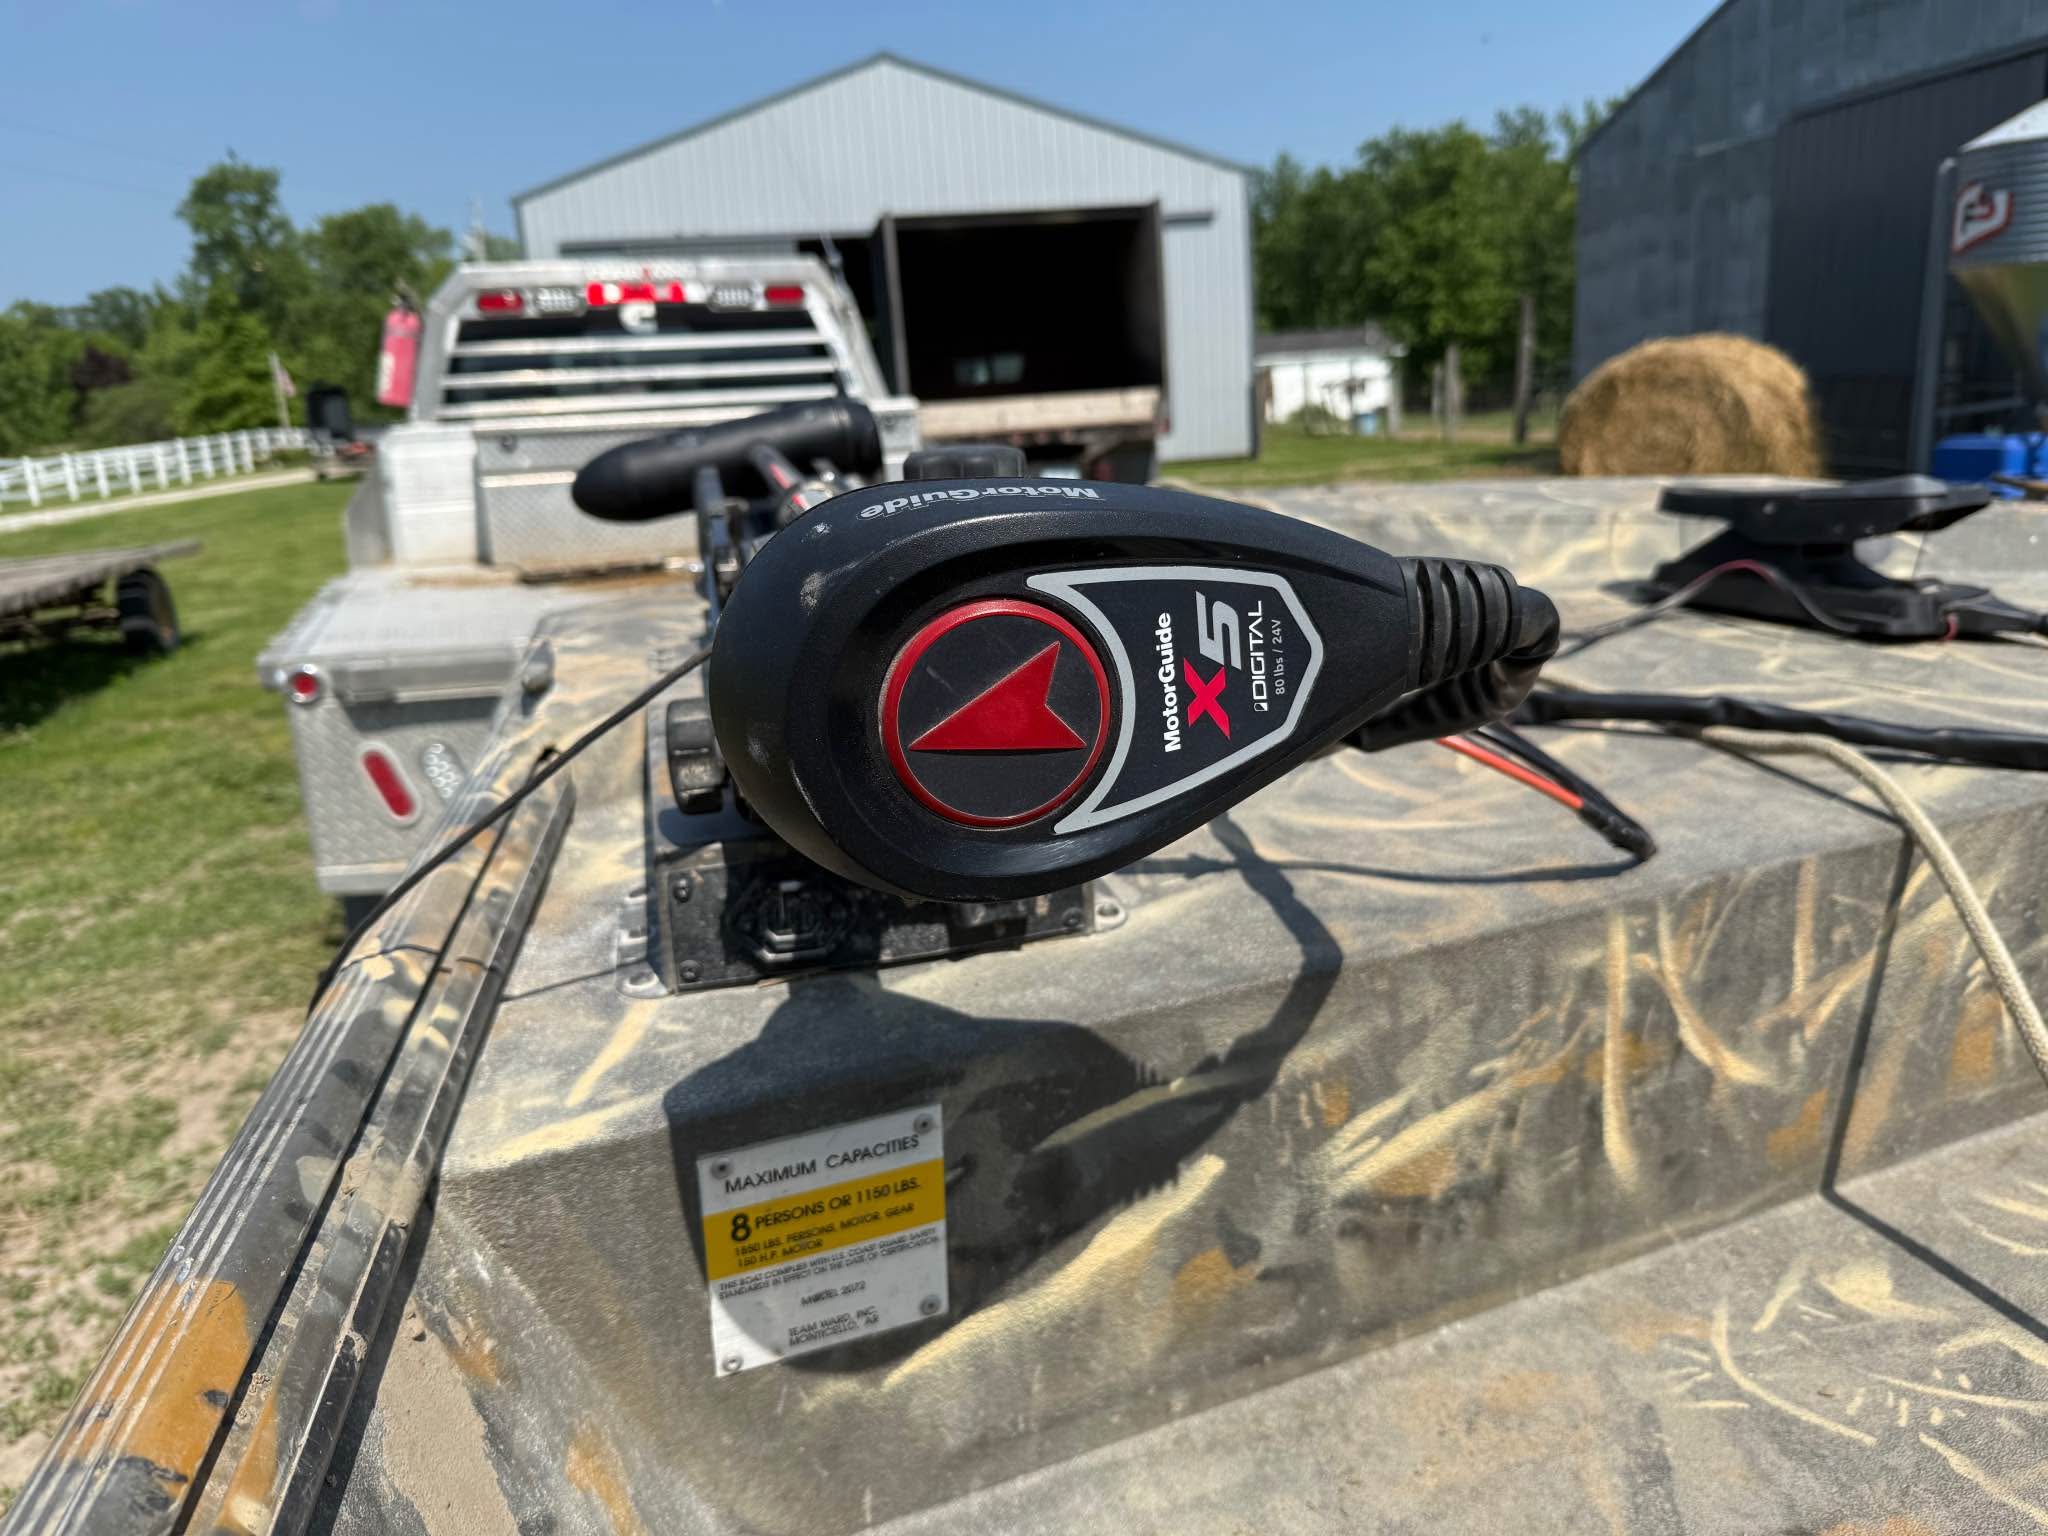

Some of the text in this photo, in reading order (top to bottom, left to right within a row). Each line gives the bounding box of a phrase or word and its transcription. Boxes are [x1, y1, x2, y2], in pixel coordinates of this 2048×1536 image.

[859, 486, 1101, 519] MotorGuide
[1271, 619, 1283, 644] 24V
[1248, 600, 1267, 702] DIGITAL
[1274, 658, 1284, 677] lbs
[1154, 612, 1182, 752] MotorGuide
[1275, 681, 1285, 695] 80
[724, 1134, 919, 1193] MAXIMUM CAPACITIES
[731, 1177, 921, 1242] 8 PERSONS OR 1150 LBS.
[885, 1203, 914, 1219] GEAR
[738, 1254, 757, 1268] 150
[783, 1239, 823, 1258] MOTOR
[720, 1279, 737, 1291] THIS
[788, 1321, 817, 1336] TEAM
